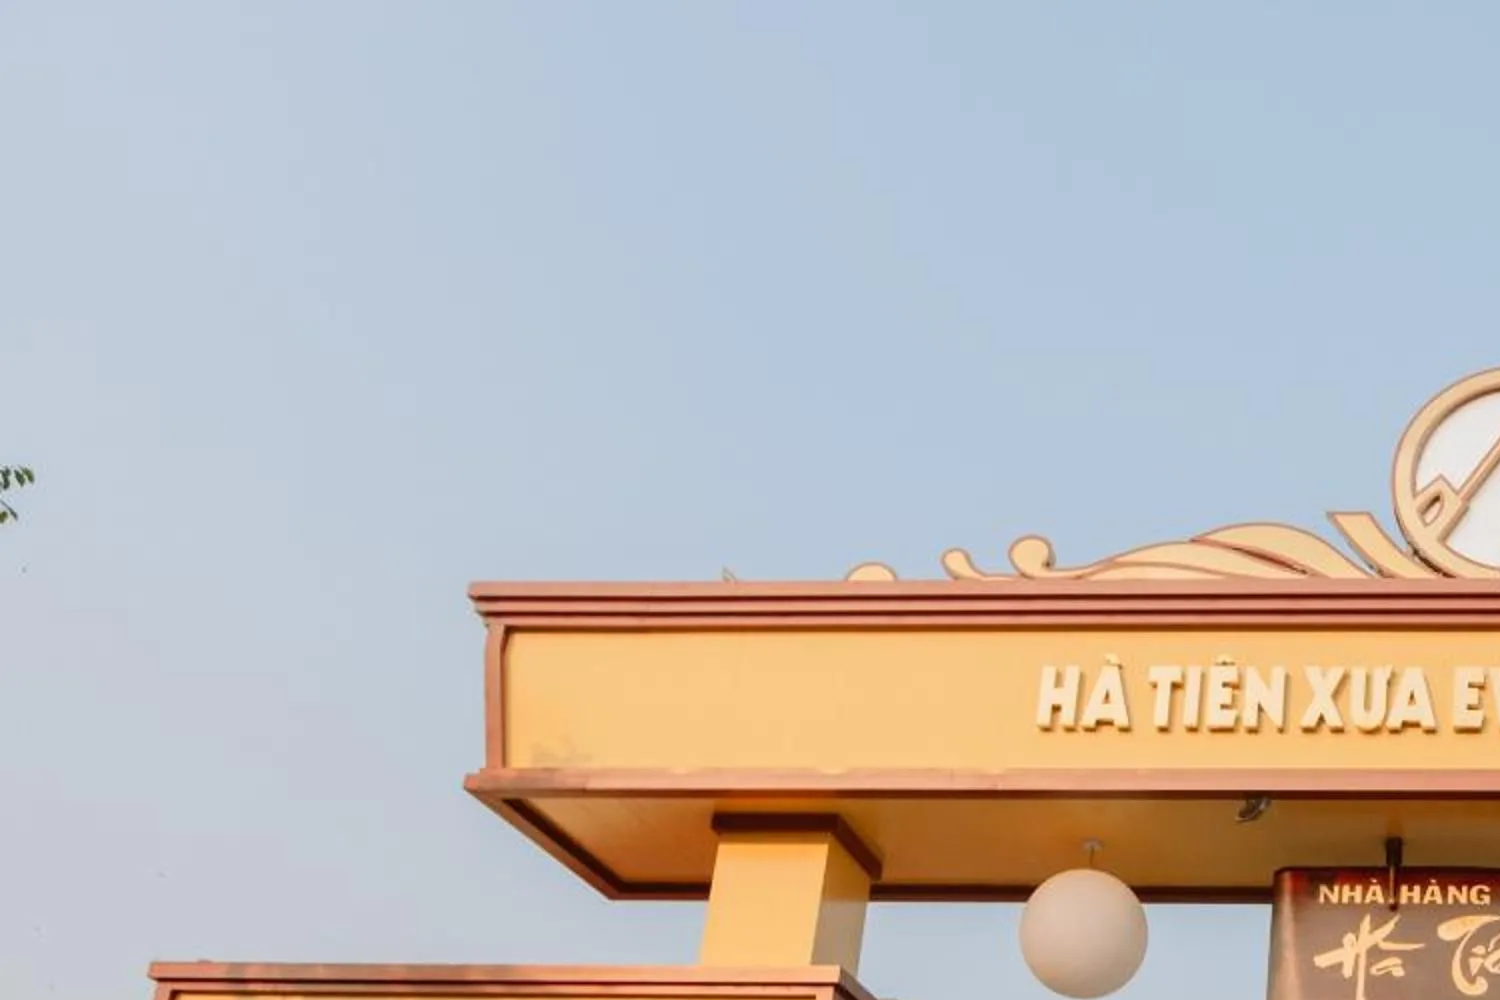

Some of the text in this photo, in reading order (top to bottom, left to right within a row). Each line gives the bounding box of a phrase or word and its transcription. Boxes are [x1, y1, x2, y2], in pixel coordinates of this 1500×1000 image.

[1036, 653, 1131, 733] HÀ
[1149, 653, 1289, 733] TIÊN
[1300, 664, 1437, 734] XƯA
[1318, 879, 1492, 906] NHÀ HÀNG
